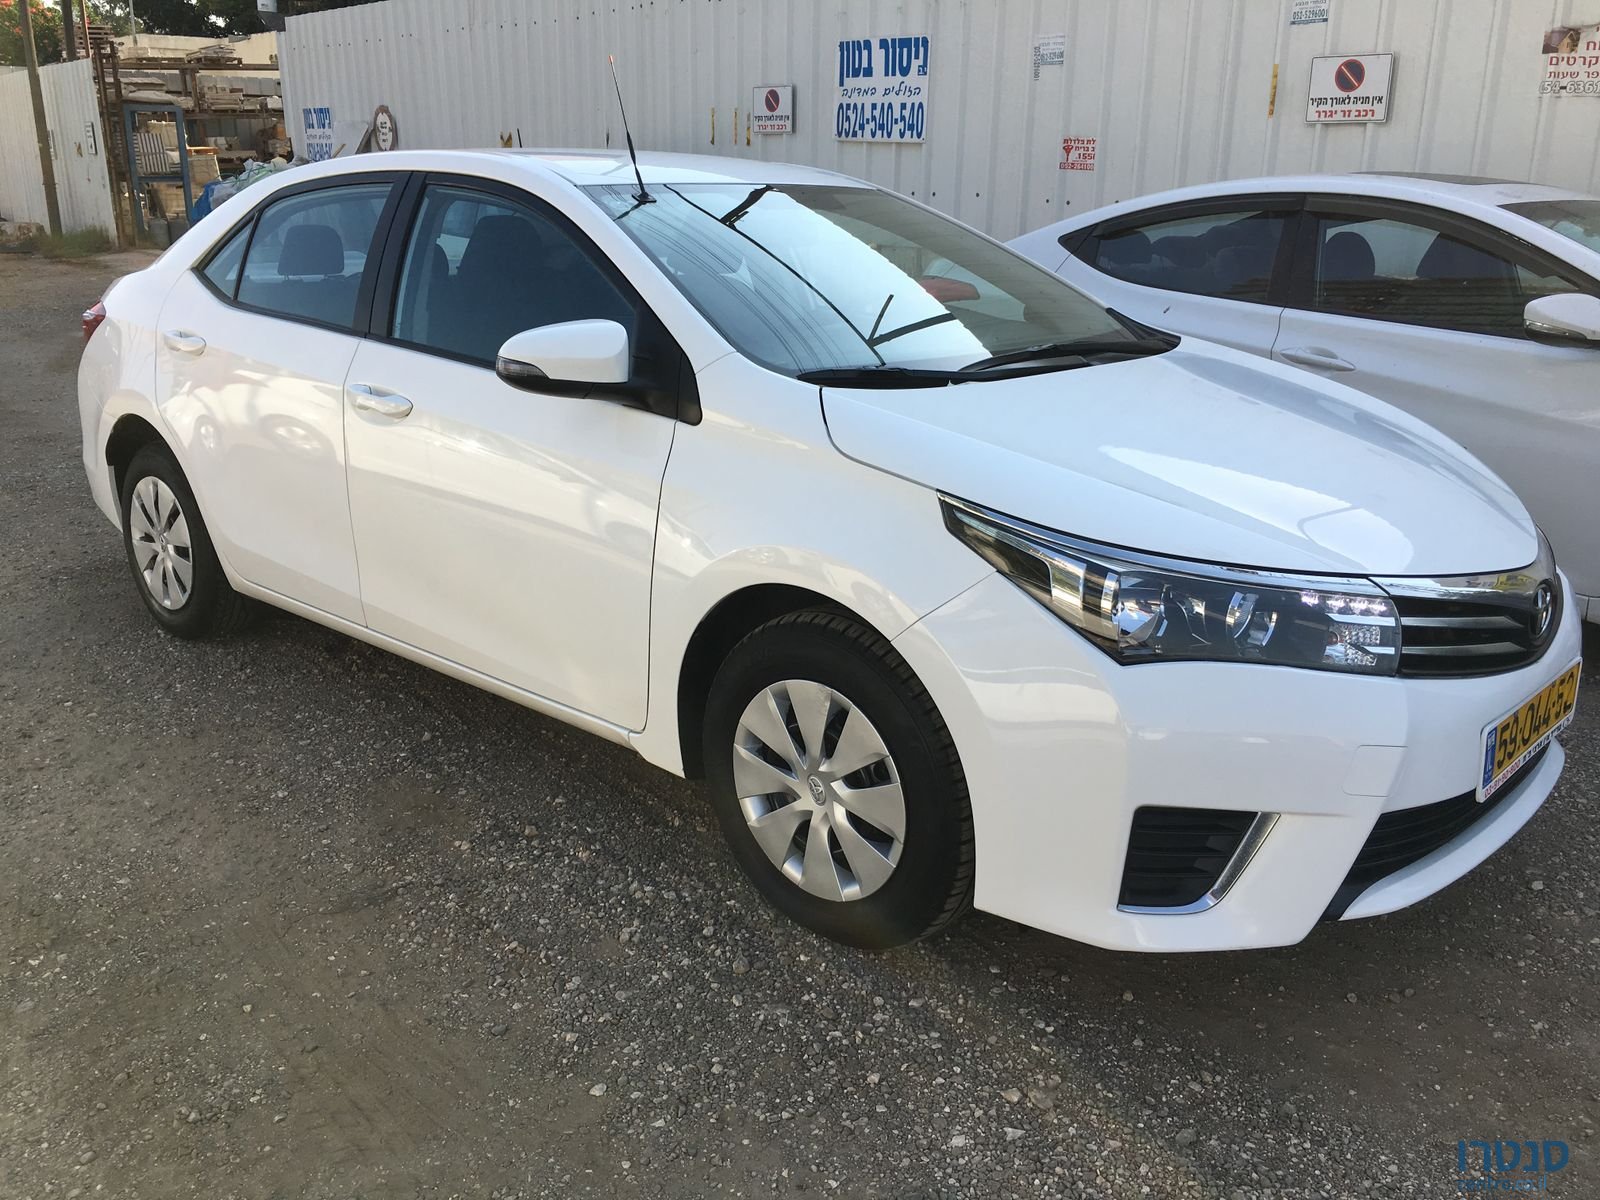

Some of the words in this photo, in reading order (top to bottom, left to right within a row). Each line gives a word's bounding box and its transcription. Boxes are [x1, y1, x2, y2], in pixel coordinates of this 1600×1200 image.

[879, 36, 929, 77] ניסור
[839, 39, 873, 87] בטון
[1547, 70, 1580, 79] שעות
[841, 87, 876, 99] במדינה
[882, 81, 921, 97] הזולים
[1310, 97, 1328, 108] הקיר
[1329, 94, 1351, 107] לאורך
[1352, 96, 1370, 105] חניה
[1371, 95, 1383, 106] אין
[1315, 110, 1337, 118] יגרר
[1340, 109, 1352, 118] זר
[1354, 109, 1375, 118] רכב
[836, 101, 925, 139] 0524-540-540
